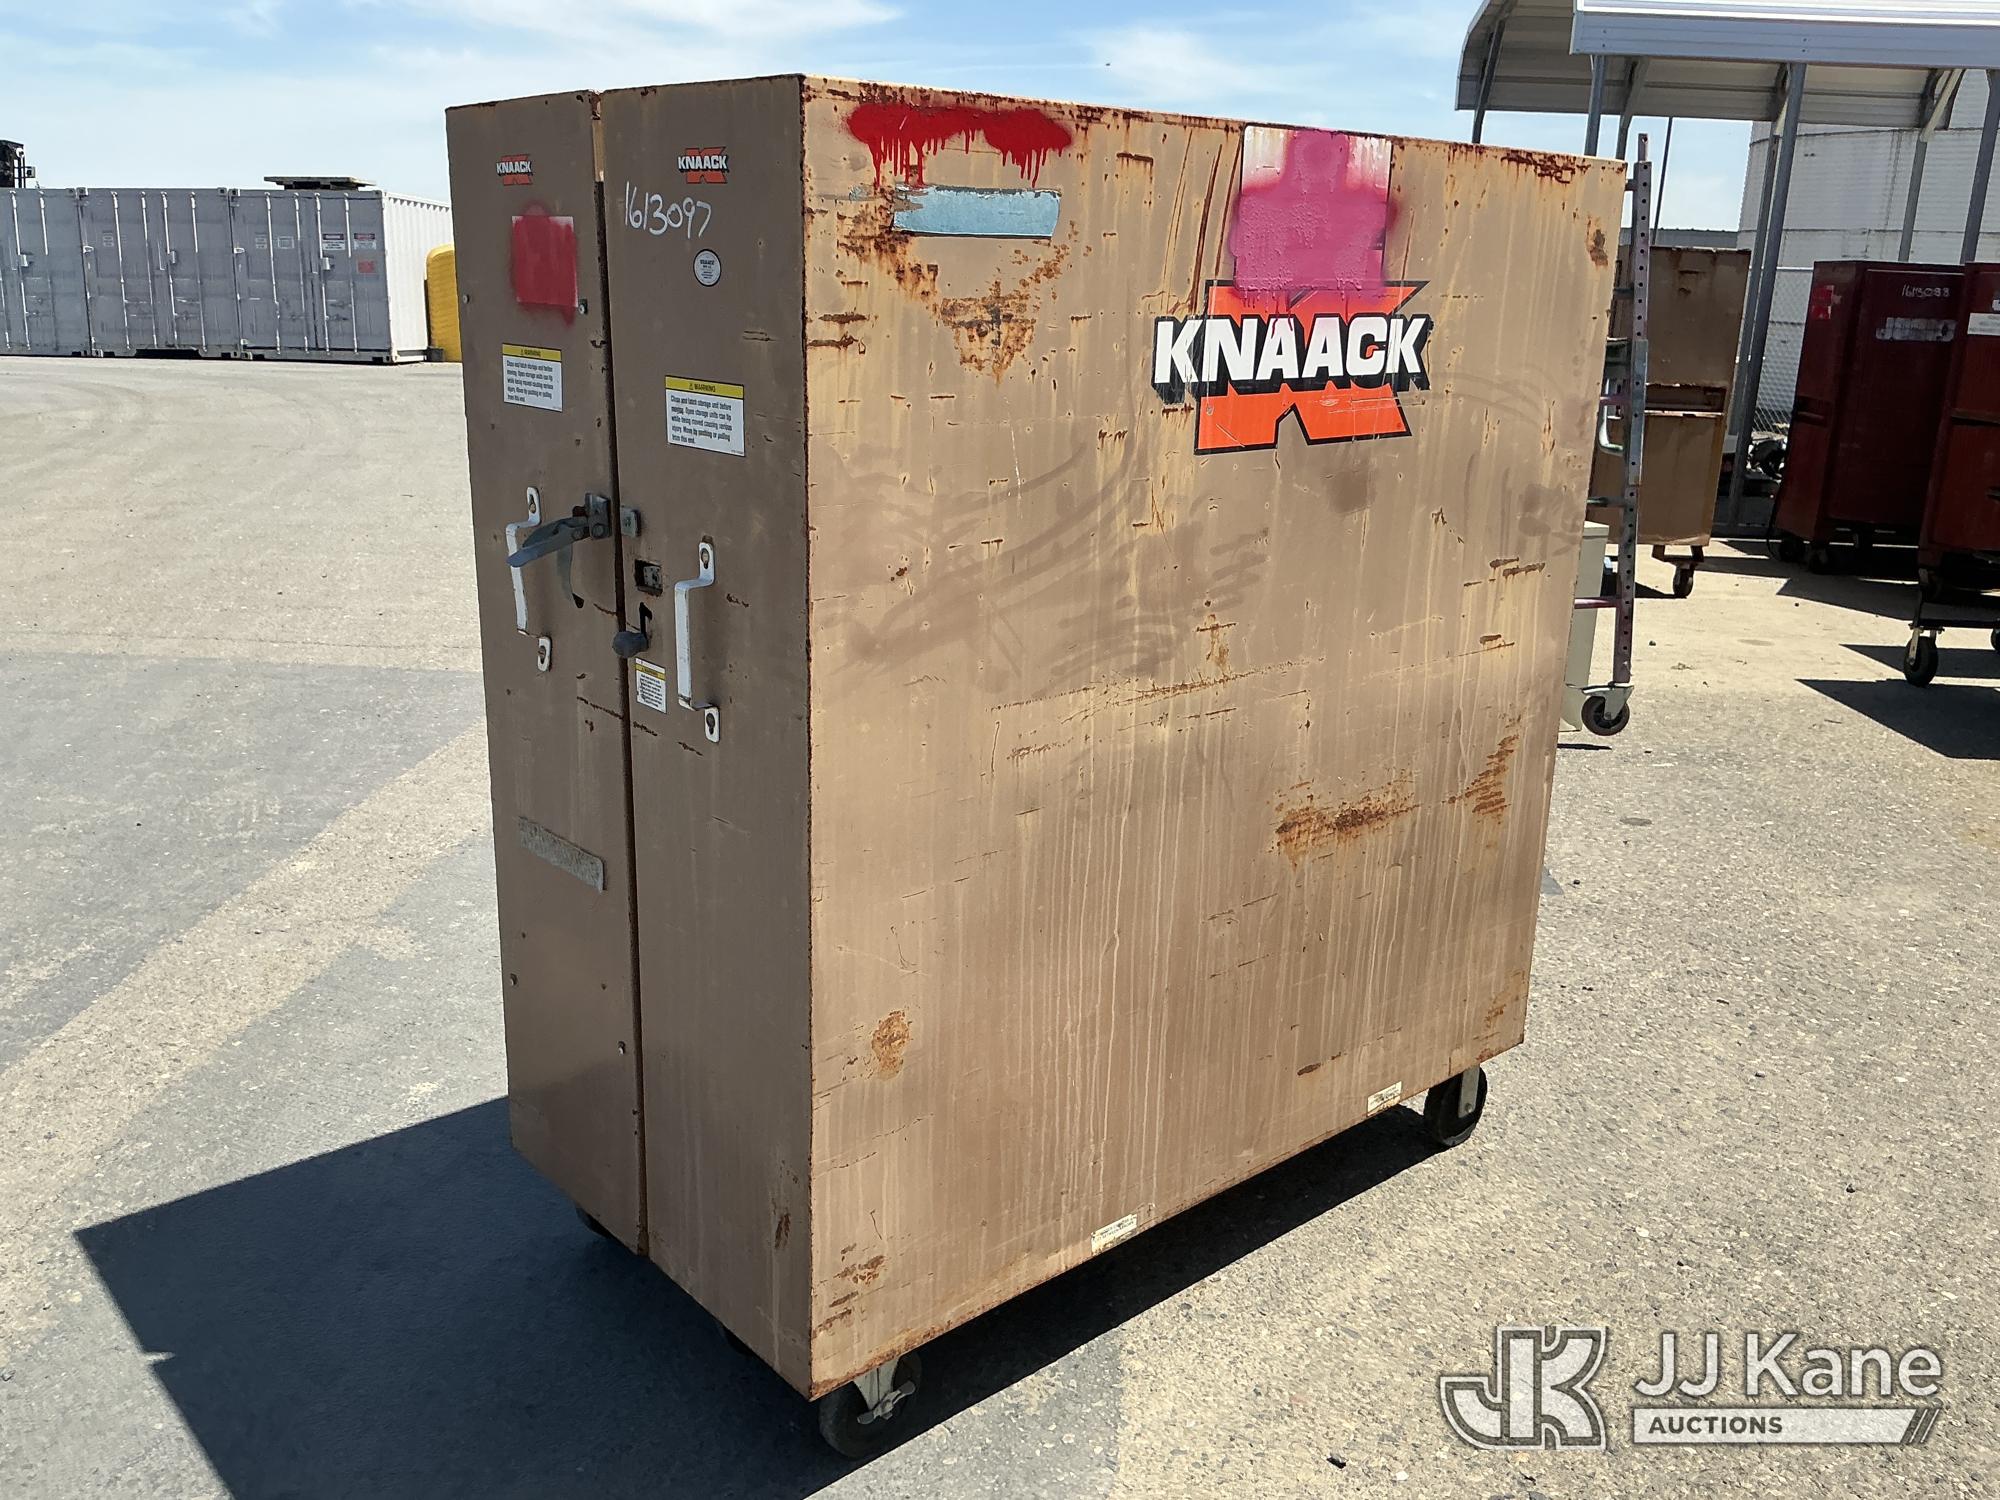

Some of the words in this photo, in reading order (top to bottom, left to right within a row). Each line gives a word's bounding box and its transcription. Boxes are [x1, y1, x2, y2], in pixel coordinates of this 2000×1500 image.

[496, 161, 532, 175] KNAACK
[677, 155, 728, 171] KNAACK
[624, 181, 712, 239] 1613097
[1153, 314, 1429, 392] KNAACK
[694, 384, 715, 392] WARNING
[695, 410, 708, 418] storage
[704, 421, 718, 430] causing
[698, 430, 712, 438] pushing
[718, 433, 730, 442] pulling
